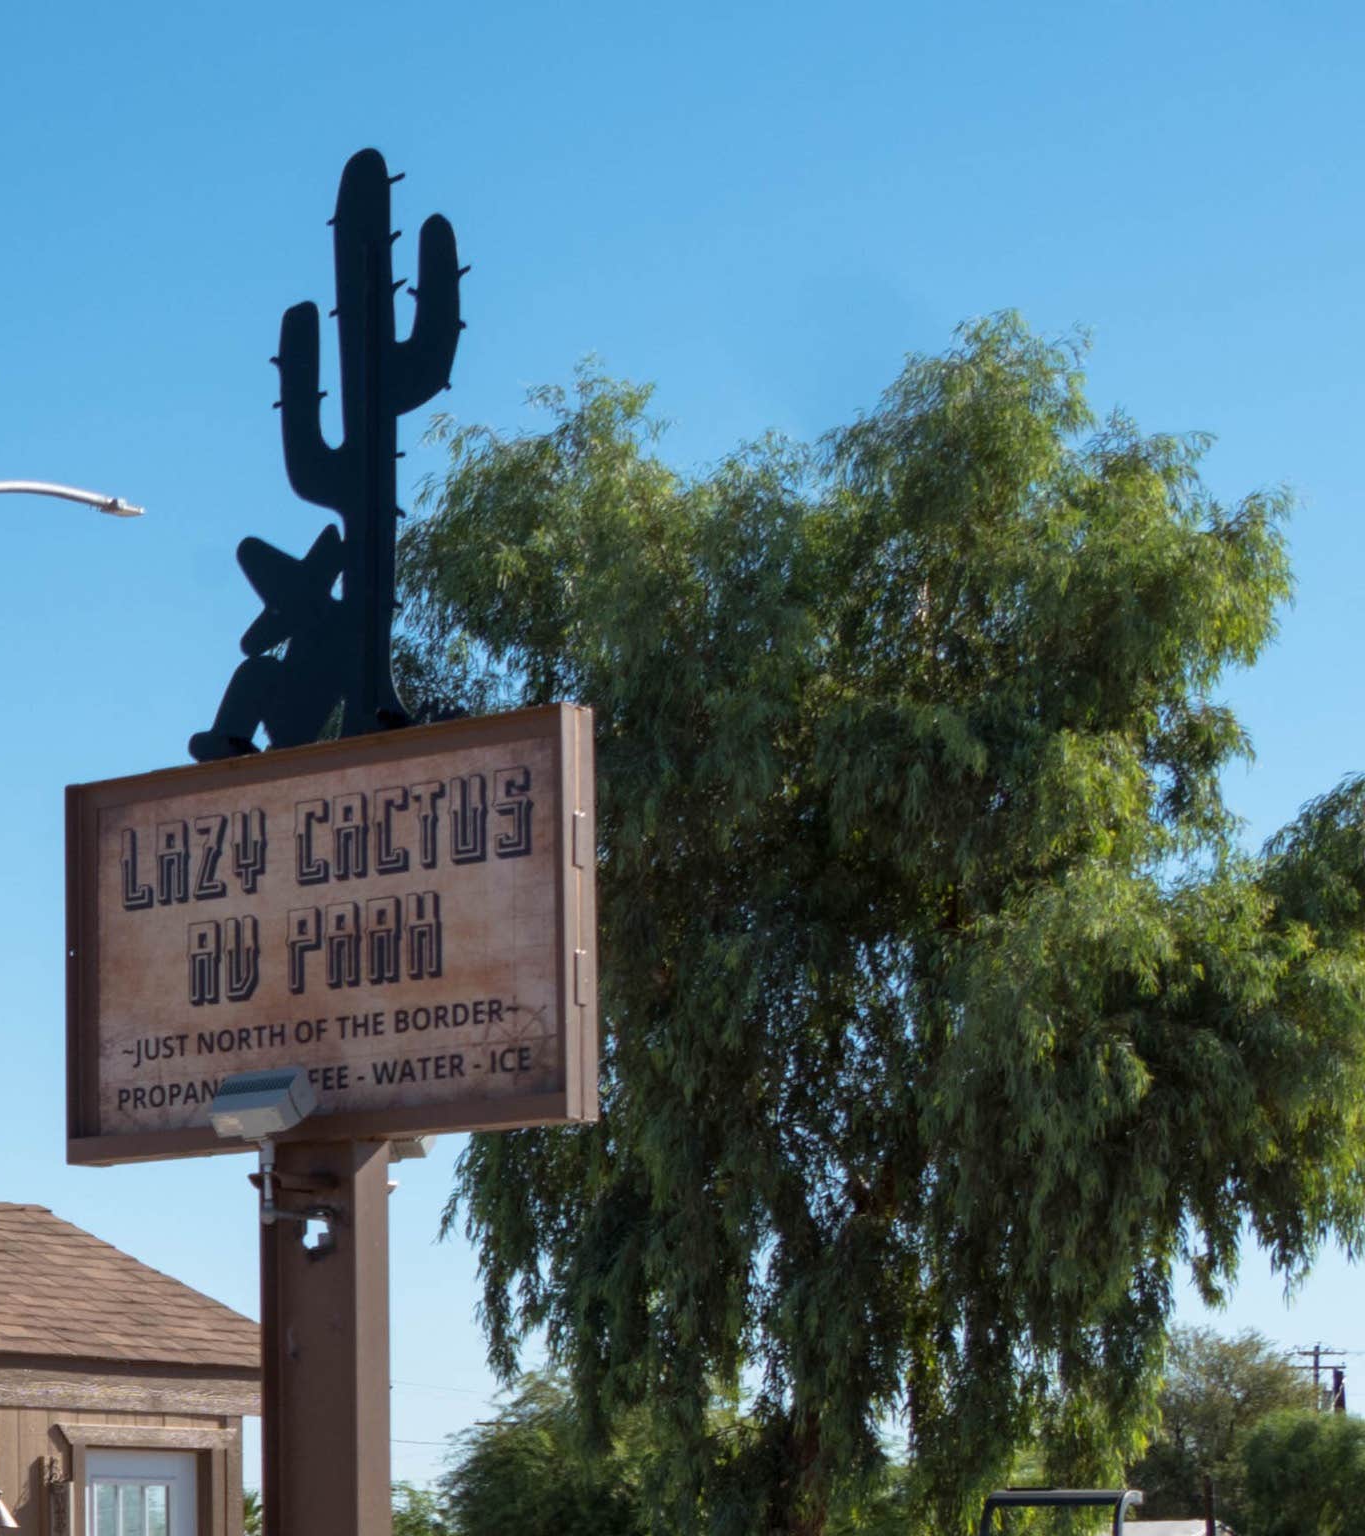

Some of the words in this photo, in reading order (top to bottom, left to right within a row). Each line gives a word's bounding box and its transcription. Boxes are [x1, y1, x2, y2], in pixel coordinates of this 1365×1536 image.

[121, 807, 267, 911] LAZY
[294, 766, 534, 885] CACTUS
[187, 914, 261, 1006] RV
[285, 890, 443, 994] PARK
[197, 1025, 286, 1055] NORTH
[294, 1019, 327, 1045] OF
[337, 1012, 385, 1039] THE
[117, 1079, 220, 1111] PROPAN
[373, 1055, 465, 1085] WATER
[490, 1047, 532, 1074] ICE
